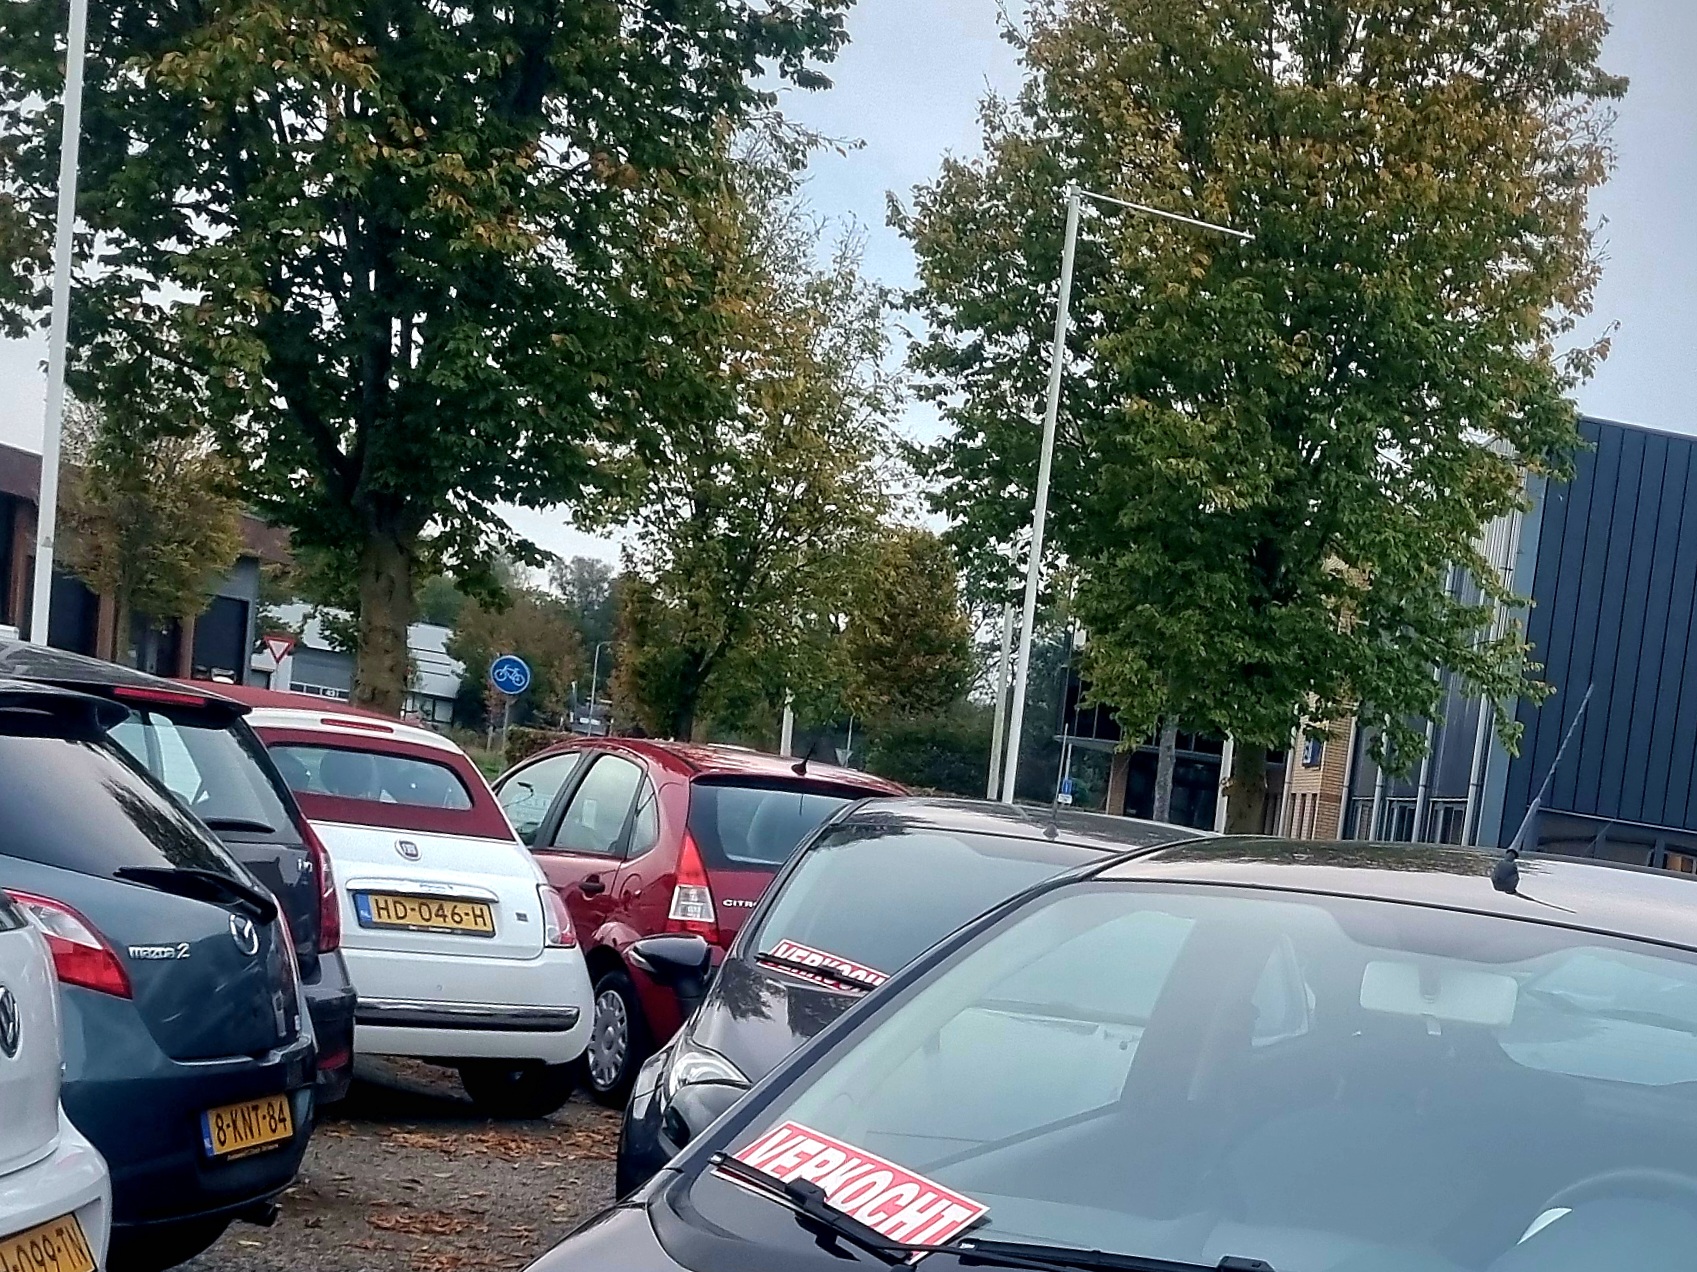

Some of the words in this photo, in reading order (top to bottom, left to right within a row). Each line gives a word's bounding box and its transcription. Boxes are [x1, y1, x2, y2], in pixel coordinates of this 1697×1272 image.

[374, 897, 488, 928] HD-046-H
[722, 899, 757, 908] CITR
[176, 942, 191, 958] 2
[215, 1100, 287, 1147] 8-KNT-84
[748, 1127, 975, 1248] VERKOCHT
